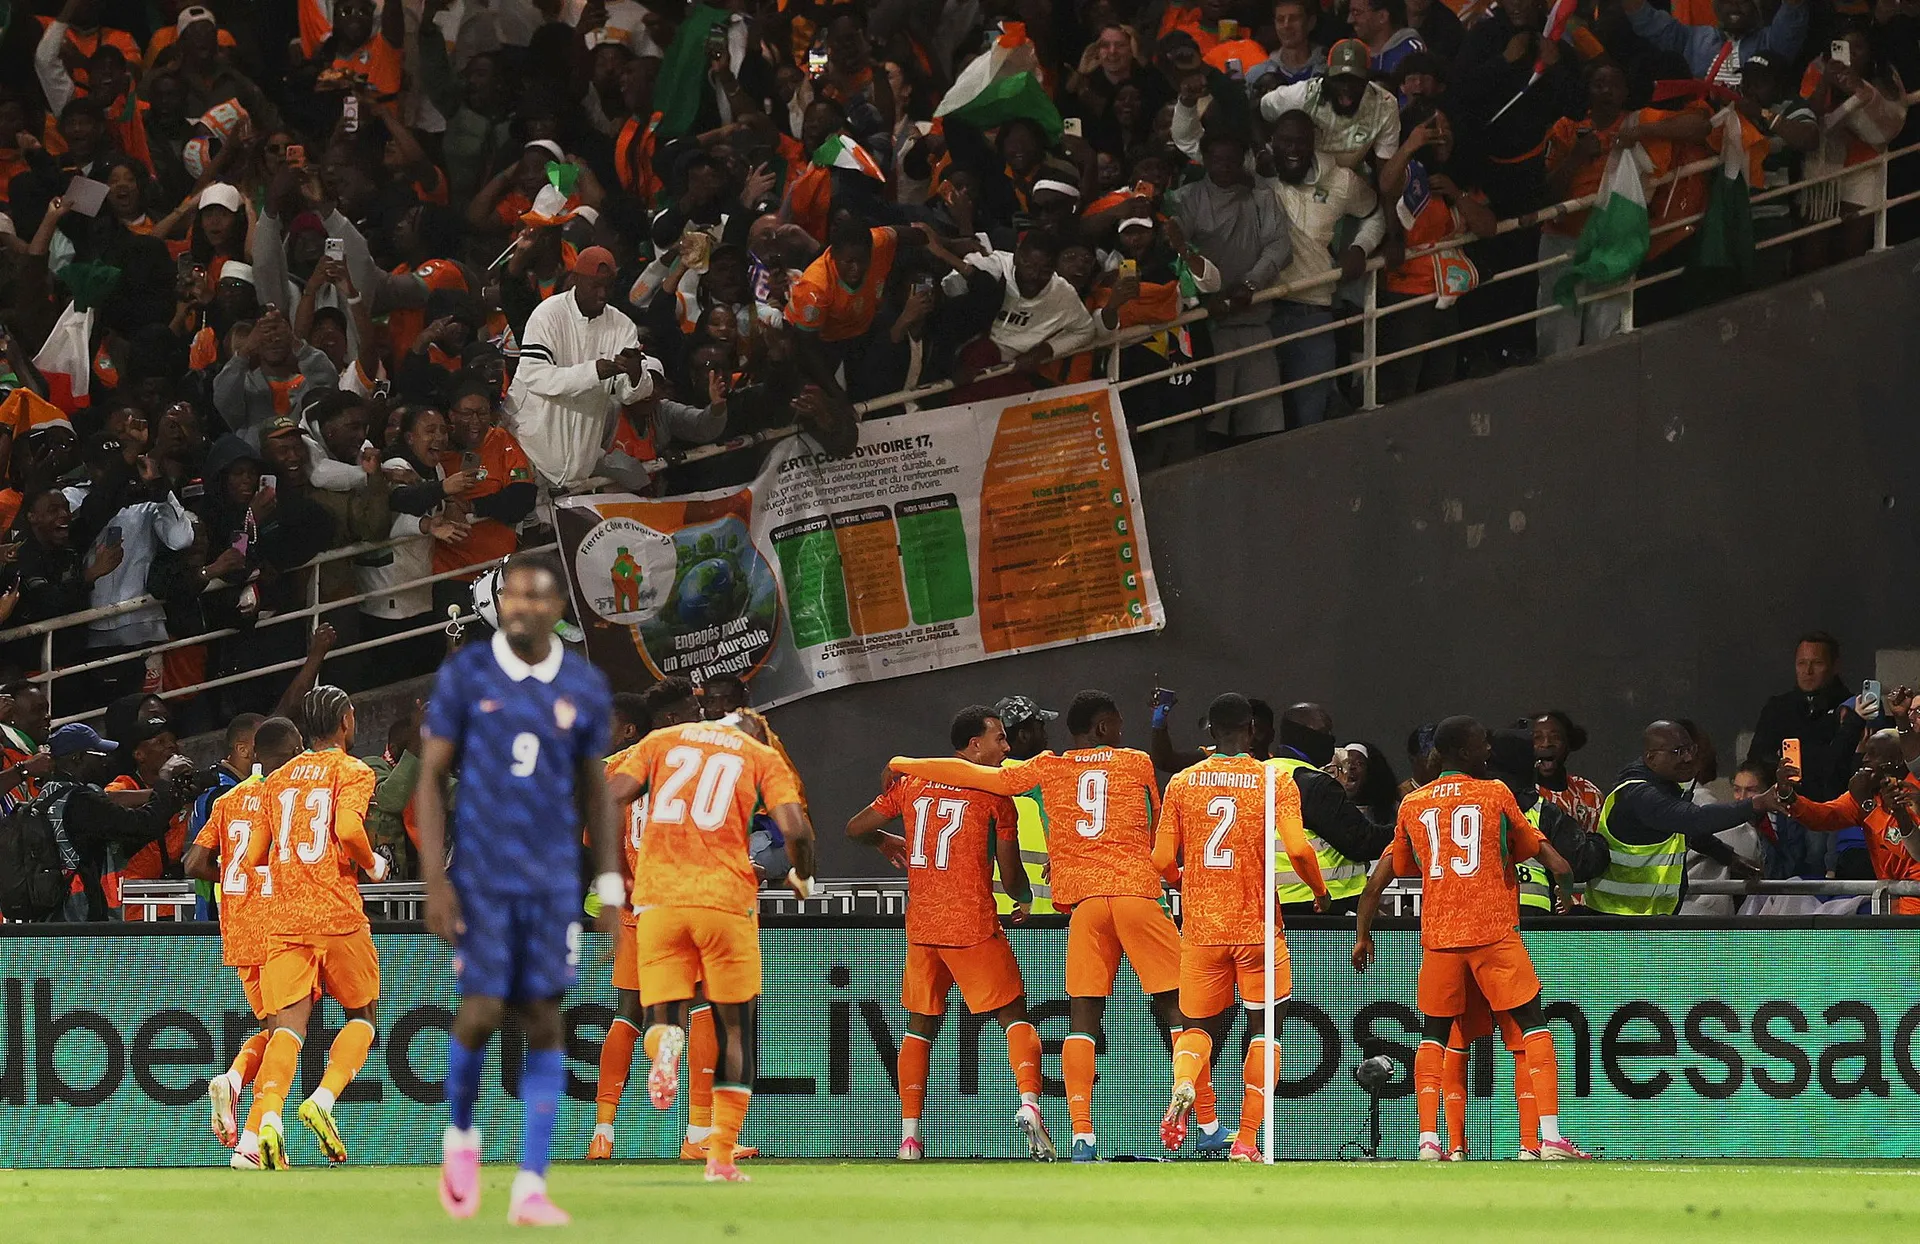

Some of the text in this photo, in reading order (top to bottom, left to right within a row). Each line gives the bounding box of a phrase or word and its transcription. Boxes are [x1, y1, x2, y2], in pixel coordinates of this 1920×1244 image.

[915, 434, 933, 449] 17,
[935, 456, 947, 465] de
[802, 490, 814, 499] de
[878, 477, 888, 486] et
[889, 474, 901, 484] du
[903, 465, 960, 481] renforcement
[876, 487, 887, 497] en
[888, 484, 909, 495] Côte
[660, 535, 671, 546] 17
[663, 629, 770, 673] un avenir durable
[673, 616, 749, 650] Engagés pour
[690, 651, 753, 684] et inclusif
[510, 731, 540, 778] 9
[651, 744, 745, 832] 20
[1075, 769, 1109, 840] 9
[1431, 782, 1463, 799] PEPE
[278, 787, 334, 864] 13
[909, 796, 970, 871] 17
[1204, 796, 1237, 869] 2
[1418, 804, 1483, 879] 19
[566, 920, 584, 966] 9
[1474, 1000, 1920, 1100] essa
